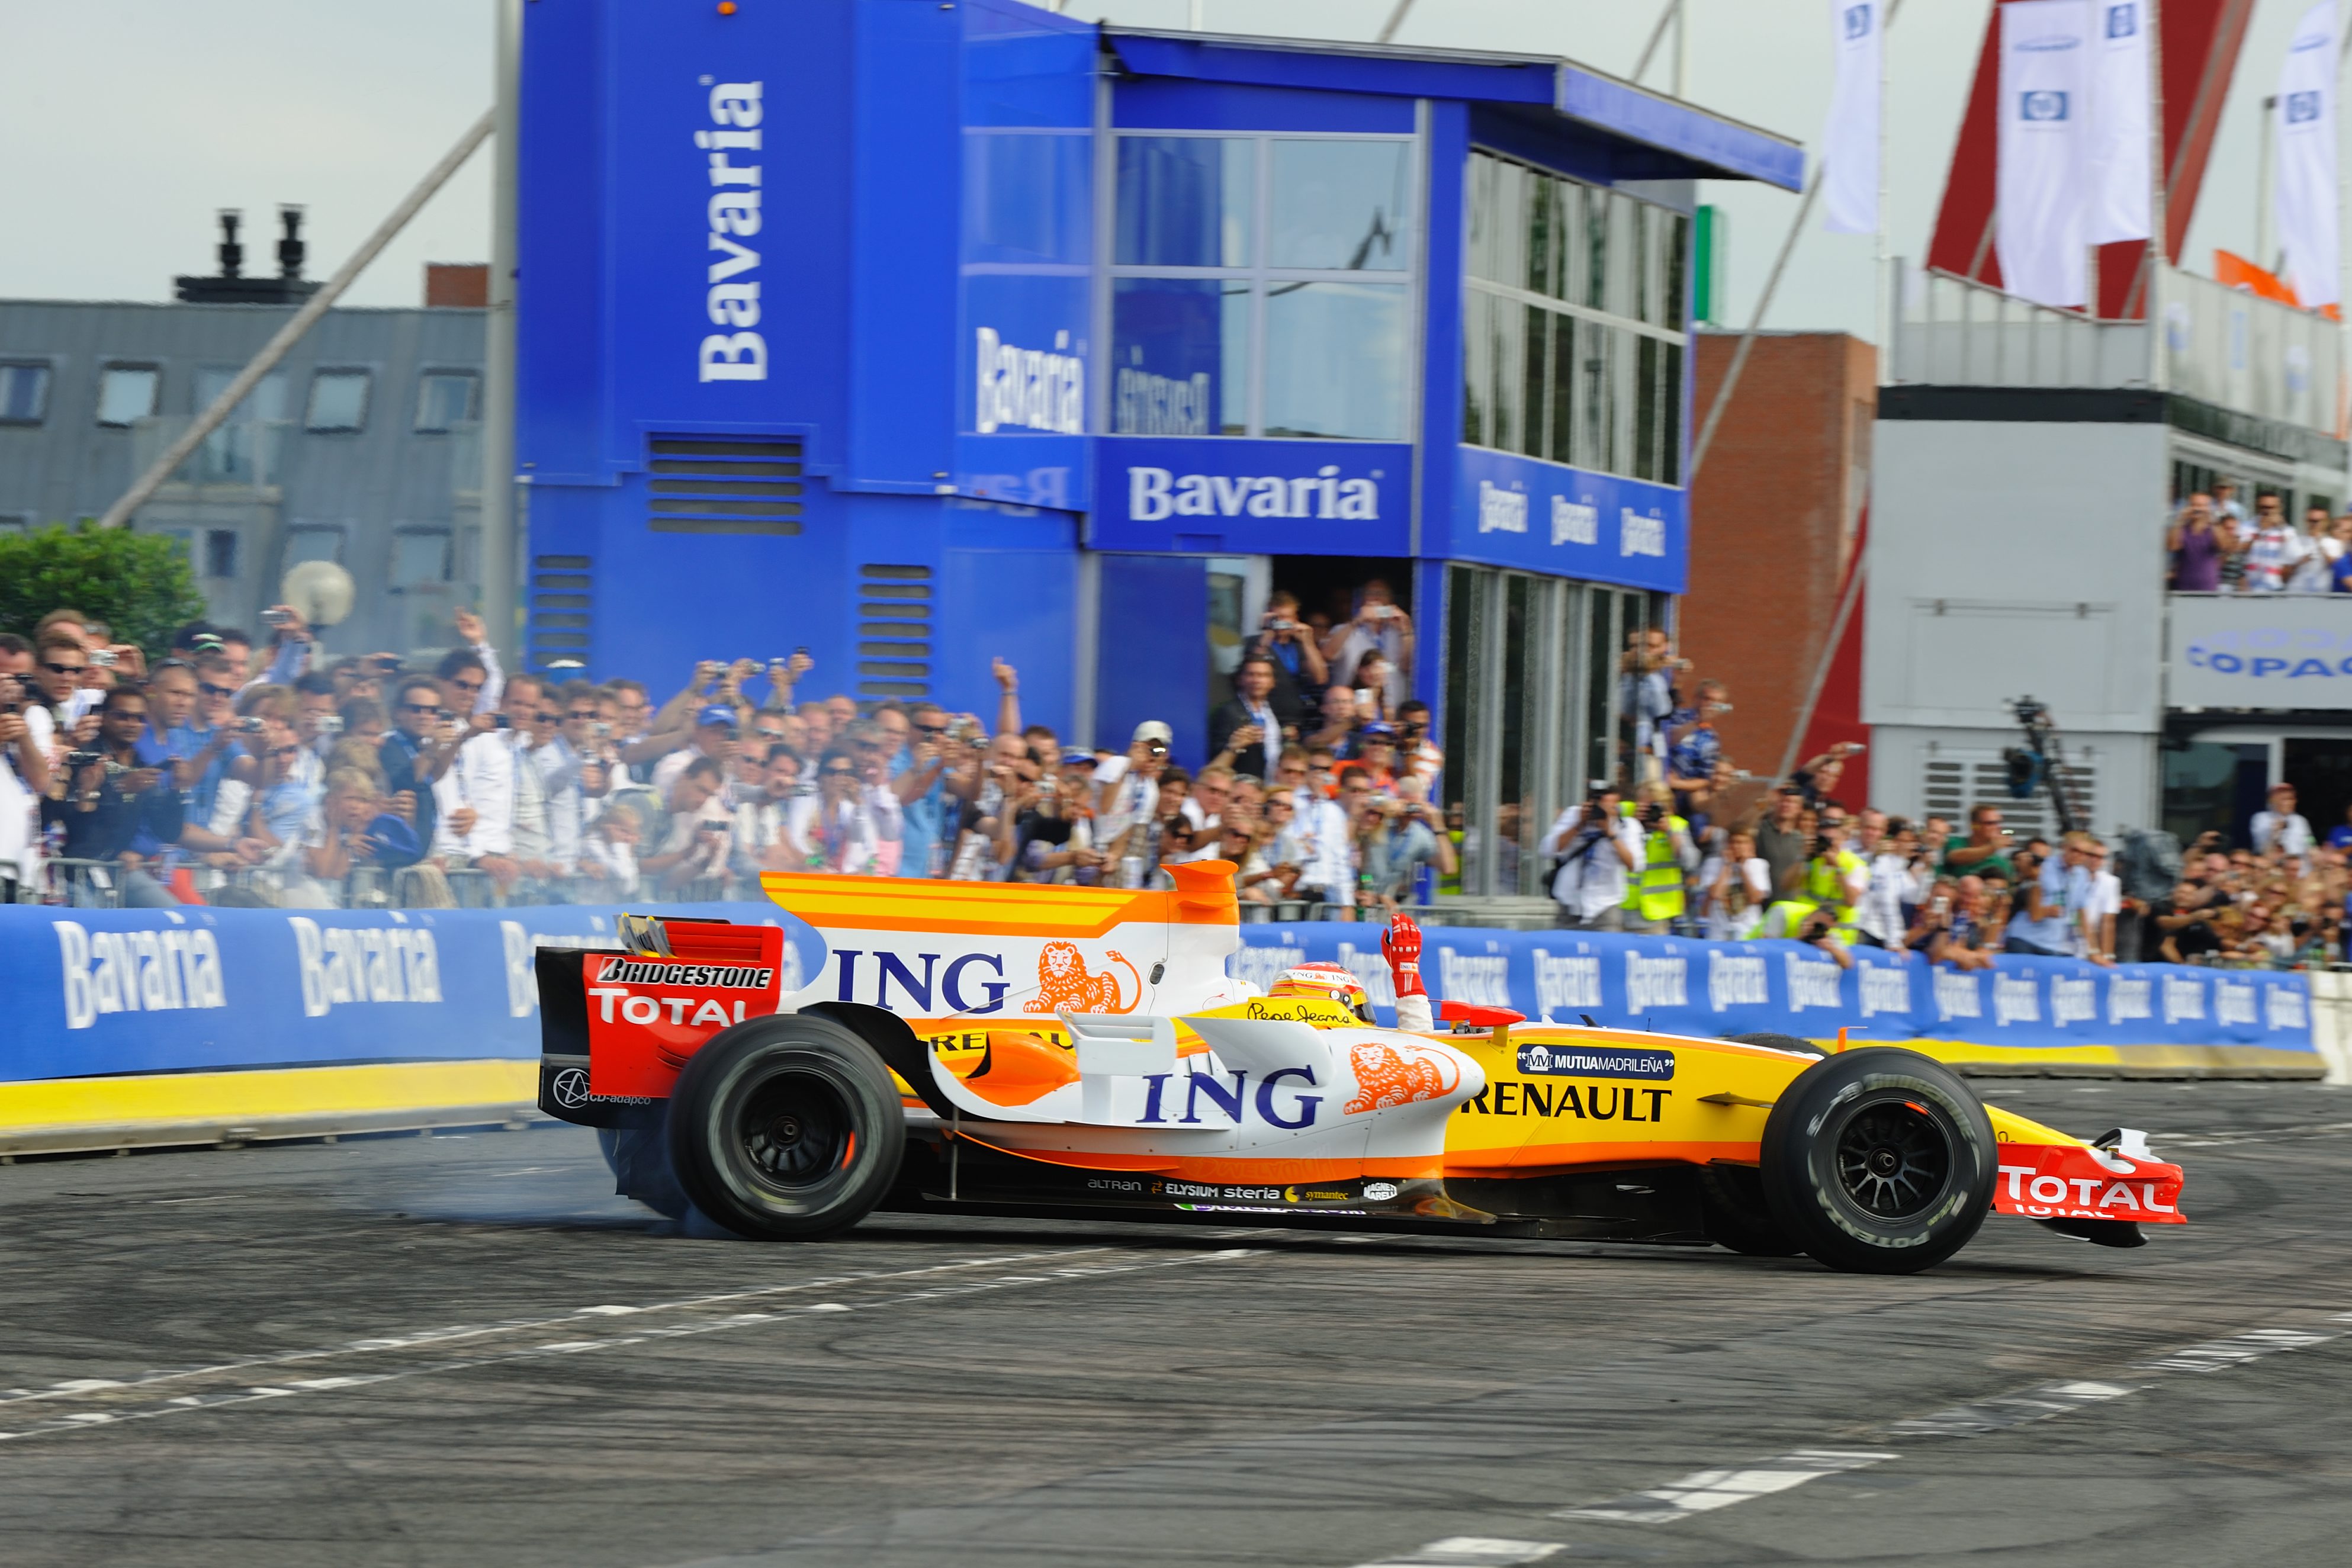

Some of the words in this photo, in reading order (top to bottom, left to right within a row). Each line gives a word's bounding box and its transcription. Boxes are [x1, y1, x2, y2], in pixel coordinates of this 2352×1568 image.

[693, 81, 768, 383] Bavaria
[1127, 465, 1380, 521] Bavaria
[52, 911, 228, 1029] Bavaria
[287, 911, 444, 1017] Bavaria
[596, 956, 774, 989] BRIDGESTONE
[832, 949, 1010, 1014] ING
[1332, 974, 1350, 983] ING
[587, 987, 746, 1027] TOTAL
[1296, 1005, 1352, 1024] Jeans
[1135, 1064, 1323, 1129] ING
[1461, 1081, 1672, 1123] RENAULT
[1165, 1183, 1219, 1198] ELYSIUM
[1223, 1186, 1280, 1200] steria
[1304, 1190, 1349, 1201] symantec
[1998, 1165, 2174, 1213] TOTAL
